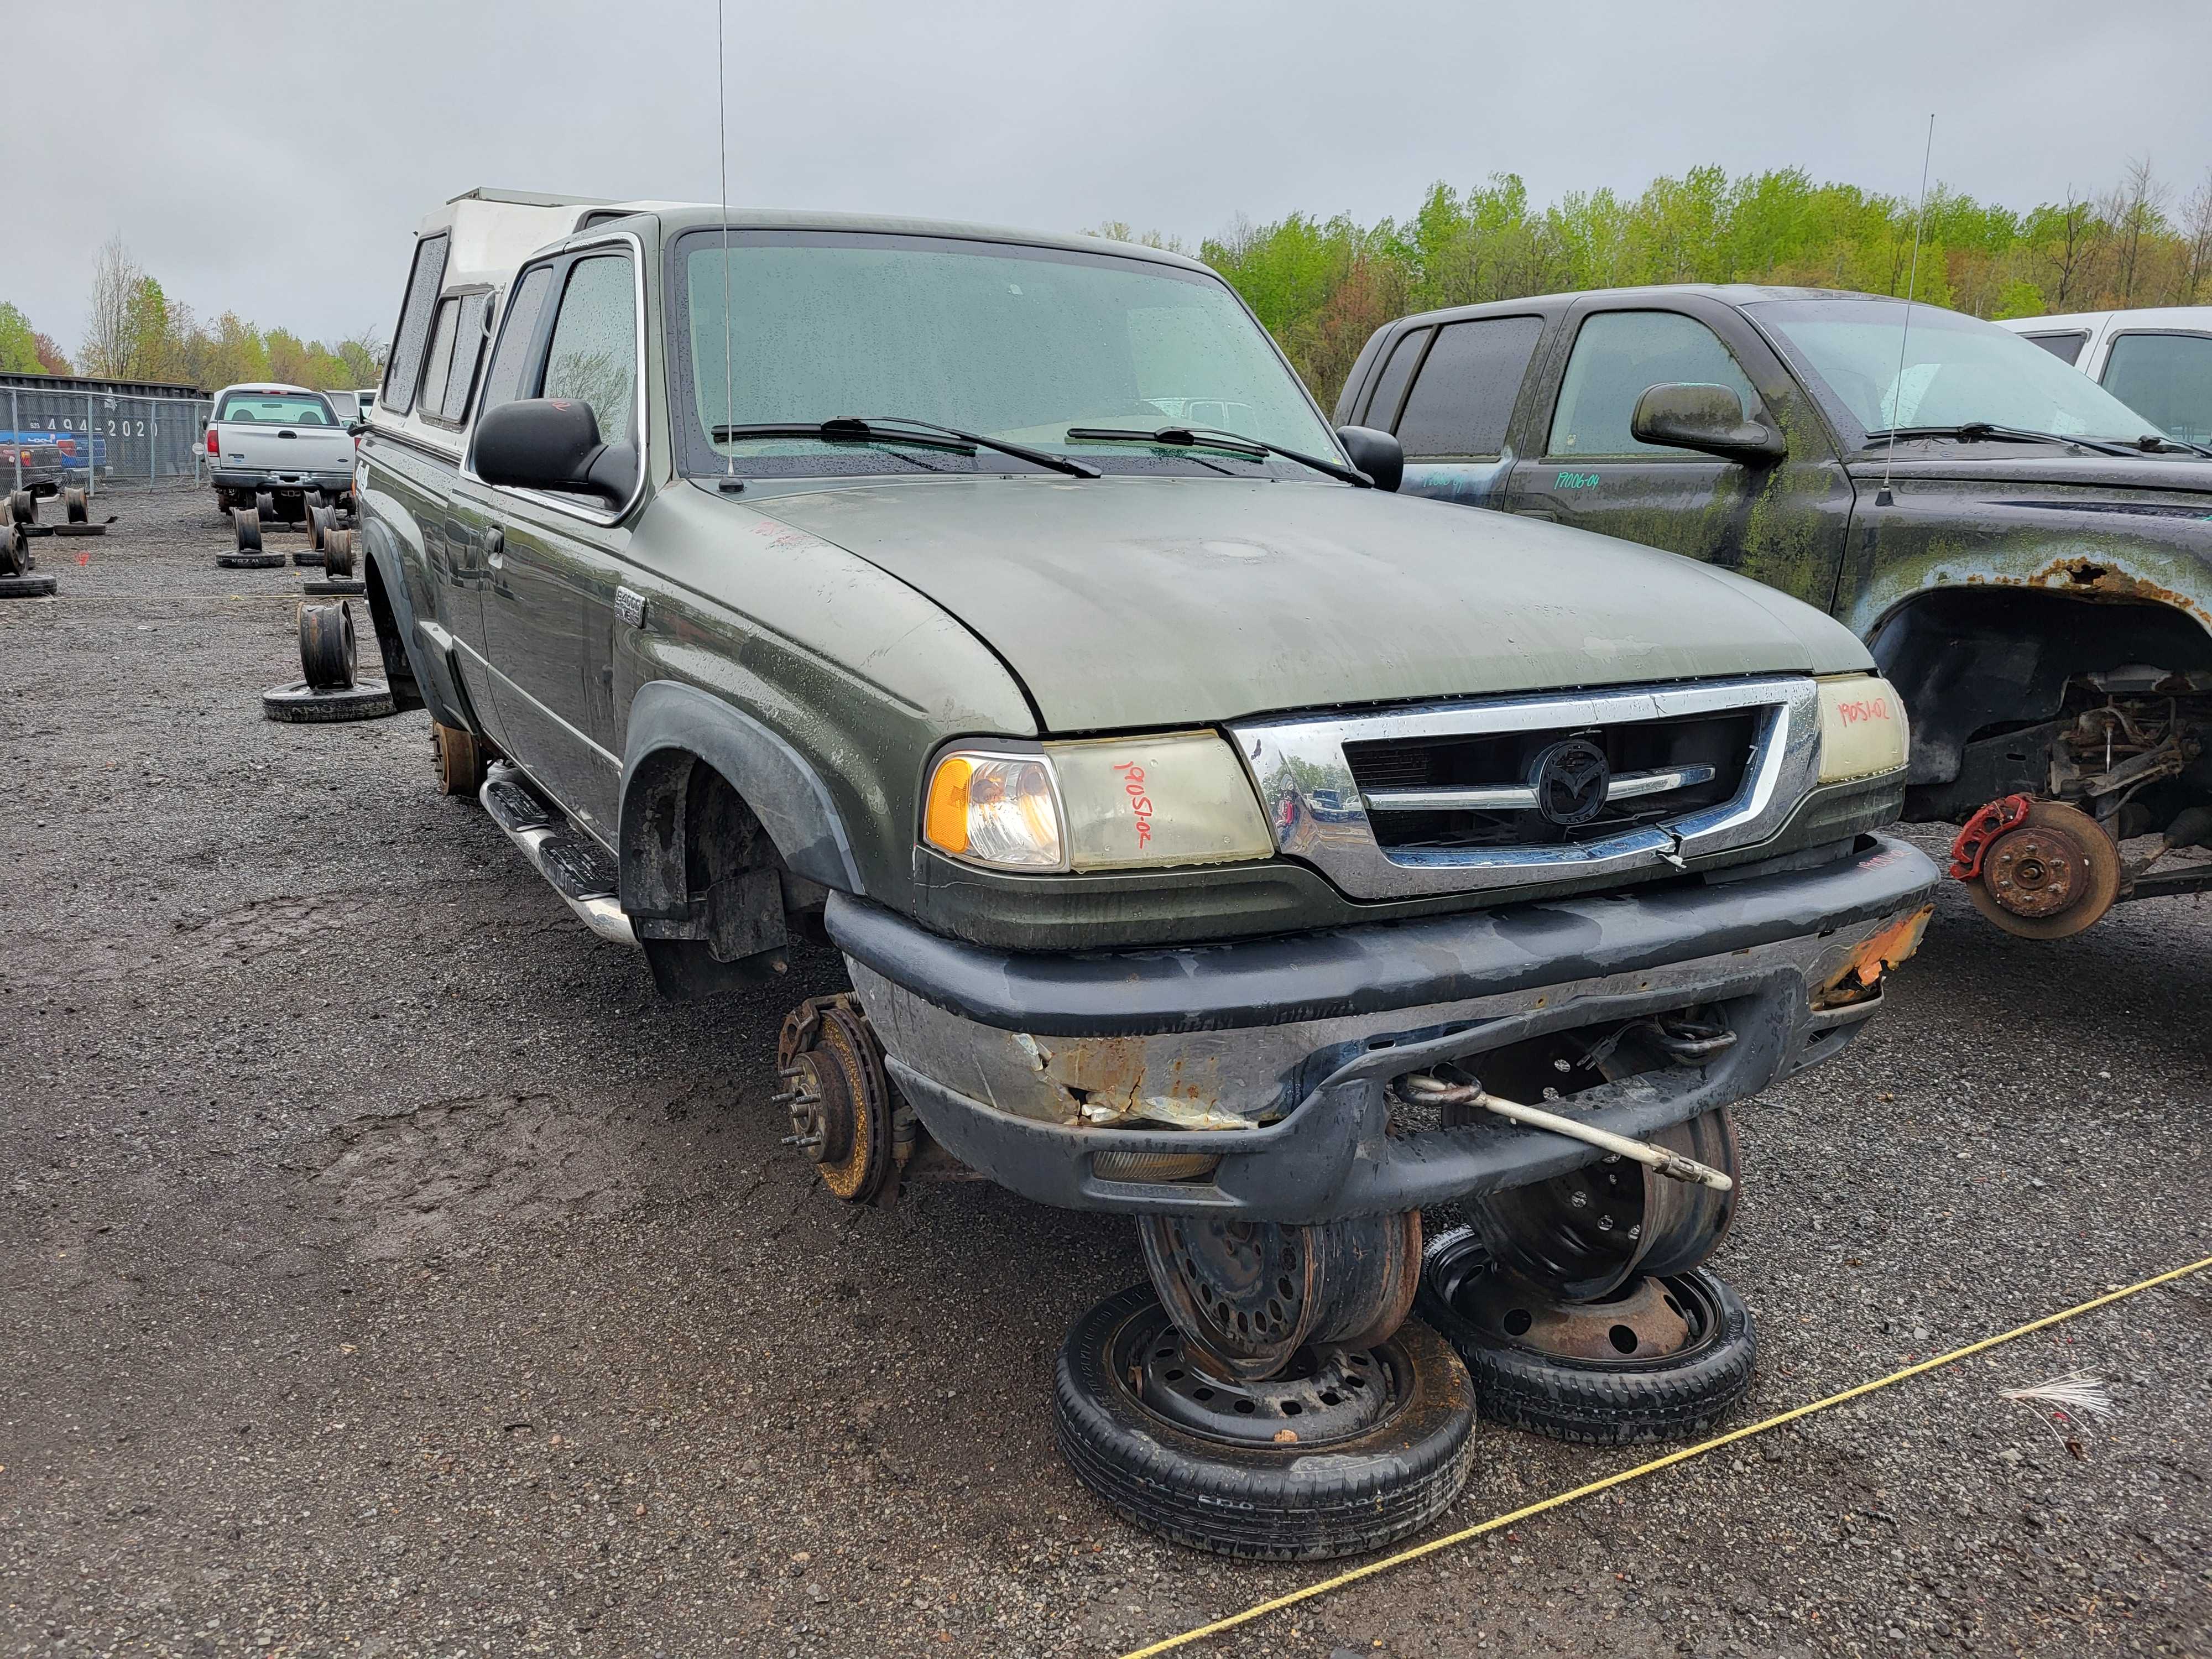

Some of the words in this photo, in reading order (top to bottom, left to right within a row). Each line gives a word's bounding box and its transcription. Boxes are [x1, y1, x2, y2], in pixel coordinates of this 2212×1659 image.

[1554, 472, 1600, 491] 19006-04
[1837, 698, 1891, 728] 19051-02
[1113, 760, 1154, 849] 19051-02
